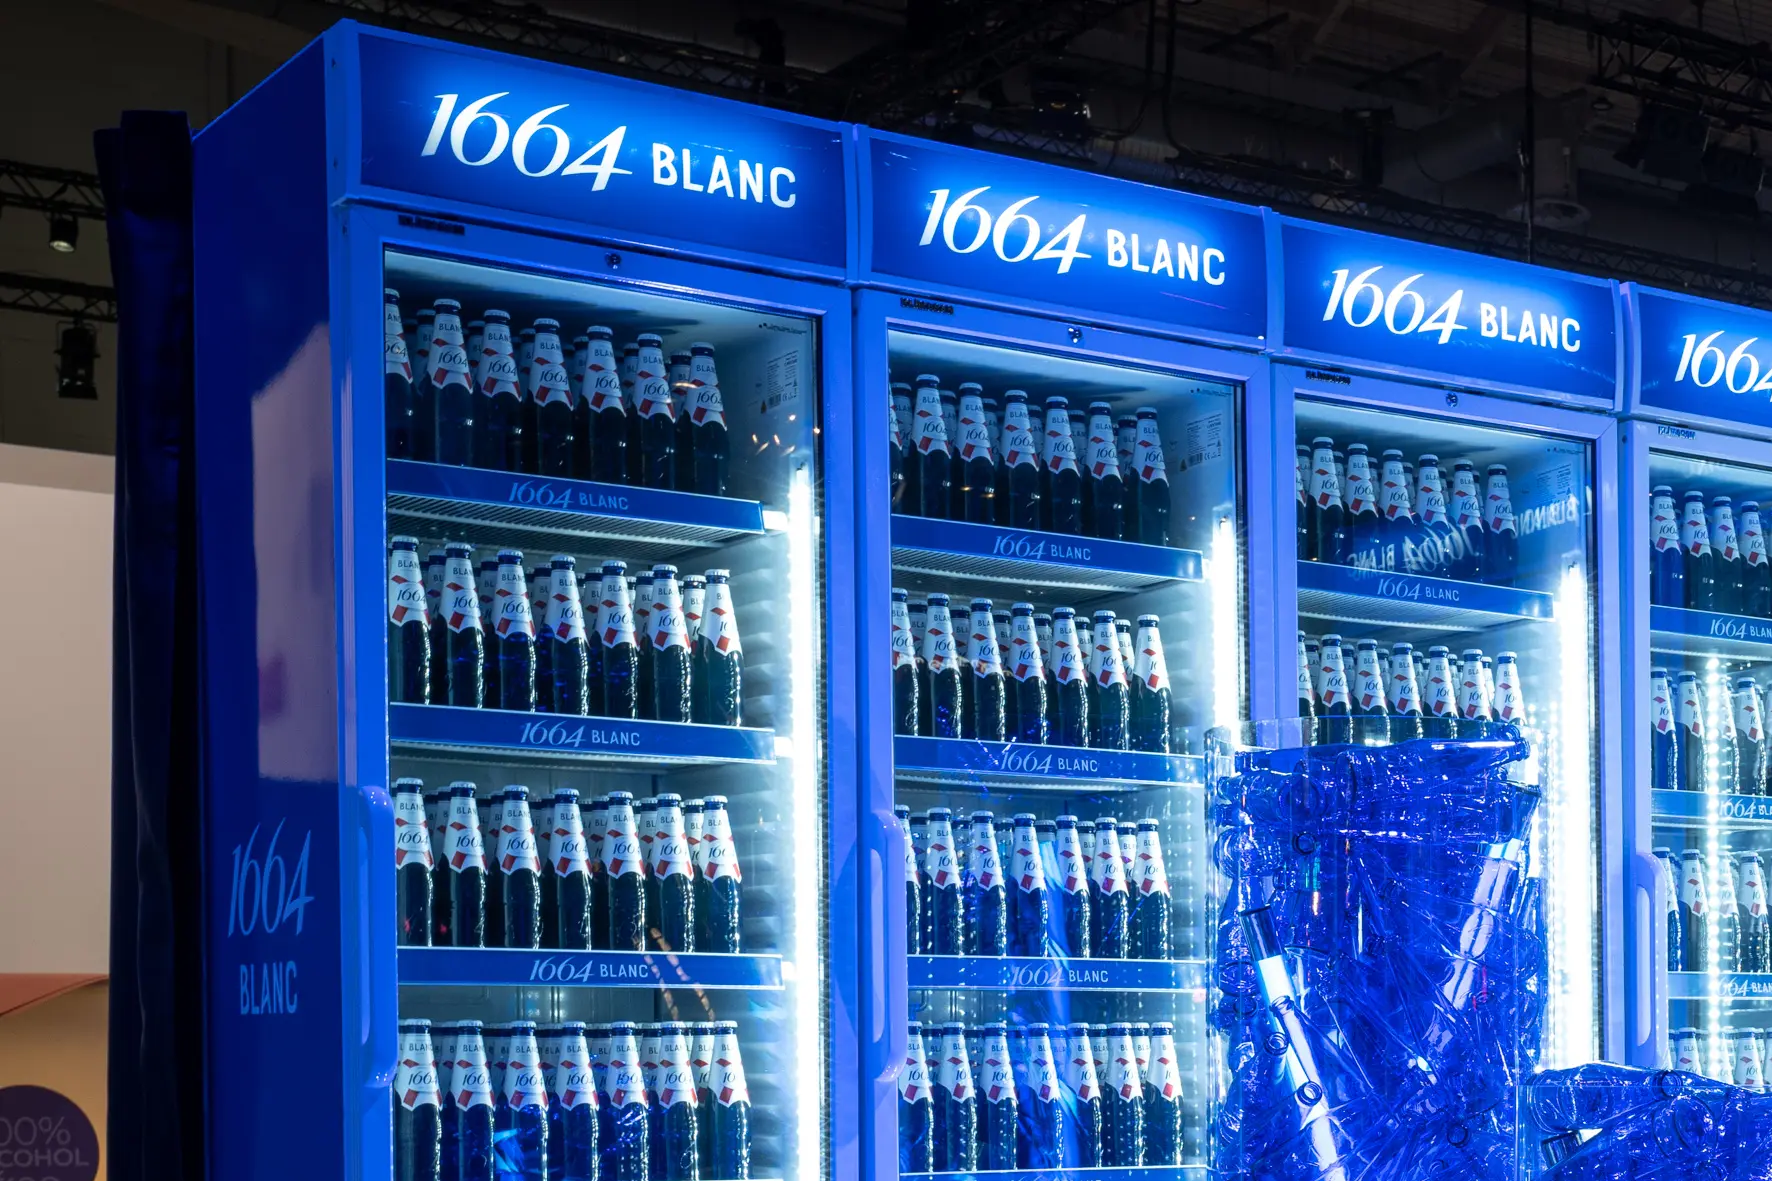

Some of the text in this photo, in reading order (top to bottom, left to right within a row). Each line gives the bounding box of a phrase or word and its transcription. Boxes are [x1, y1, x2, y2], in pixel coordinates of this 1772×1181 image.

[429, 93, 795, 207] 1664 BLANC
[922, 187, 1224, 285] 1664 BLANC
[1324, 266, 1580, 352] 1664 BLANC
[438, 322, 462, 332] BLAN
[487, 332, 510, 342] BLAN
[540, 341, 560, 350] BLAN
[923, 396, 940, 404] BLAN
[509, 481, 629, 511] 1664 BLANC
[992, 535, 1091, 561] 1664 BLANC
[397, 559, 420, 569] BLAN
[502, 572, 525, 582] BLAN
[1377, 577, 1460, 601] 1664 BLANC
[1710, 619, 1748, 640] 1664
[934, 640, 954, 652] 166
[1019, 648, 1042, 661] 166
[521, 720, 640, 748] 1664 BLANC
[1000, 750, 1098, 774] 1664 BLANC
[508, 808, 531, 818] BLAN
[228, 817, 315, 938] 1664
[530, 956, 649, 983] 1664 BLANC
[1011, 963, 1109, 987] 1664 BLANC
[240, 961, 298, 1015] BLANC
[1716, 977, 1751, 997] 664
[409, 1043, 432, 1052] BLAN
[463, 1043, 484, 1052] BLAN
[516, 1044, 539, 1053] BLAN
